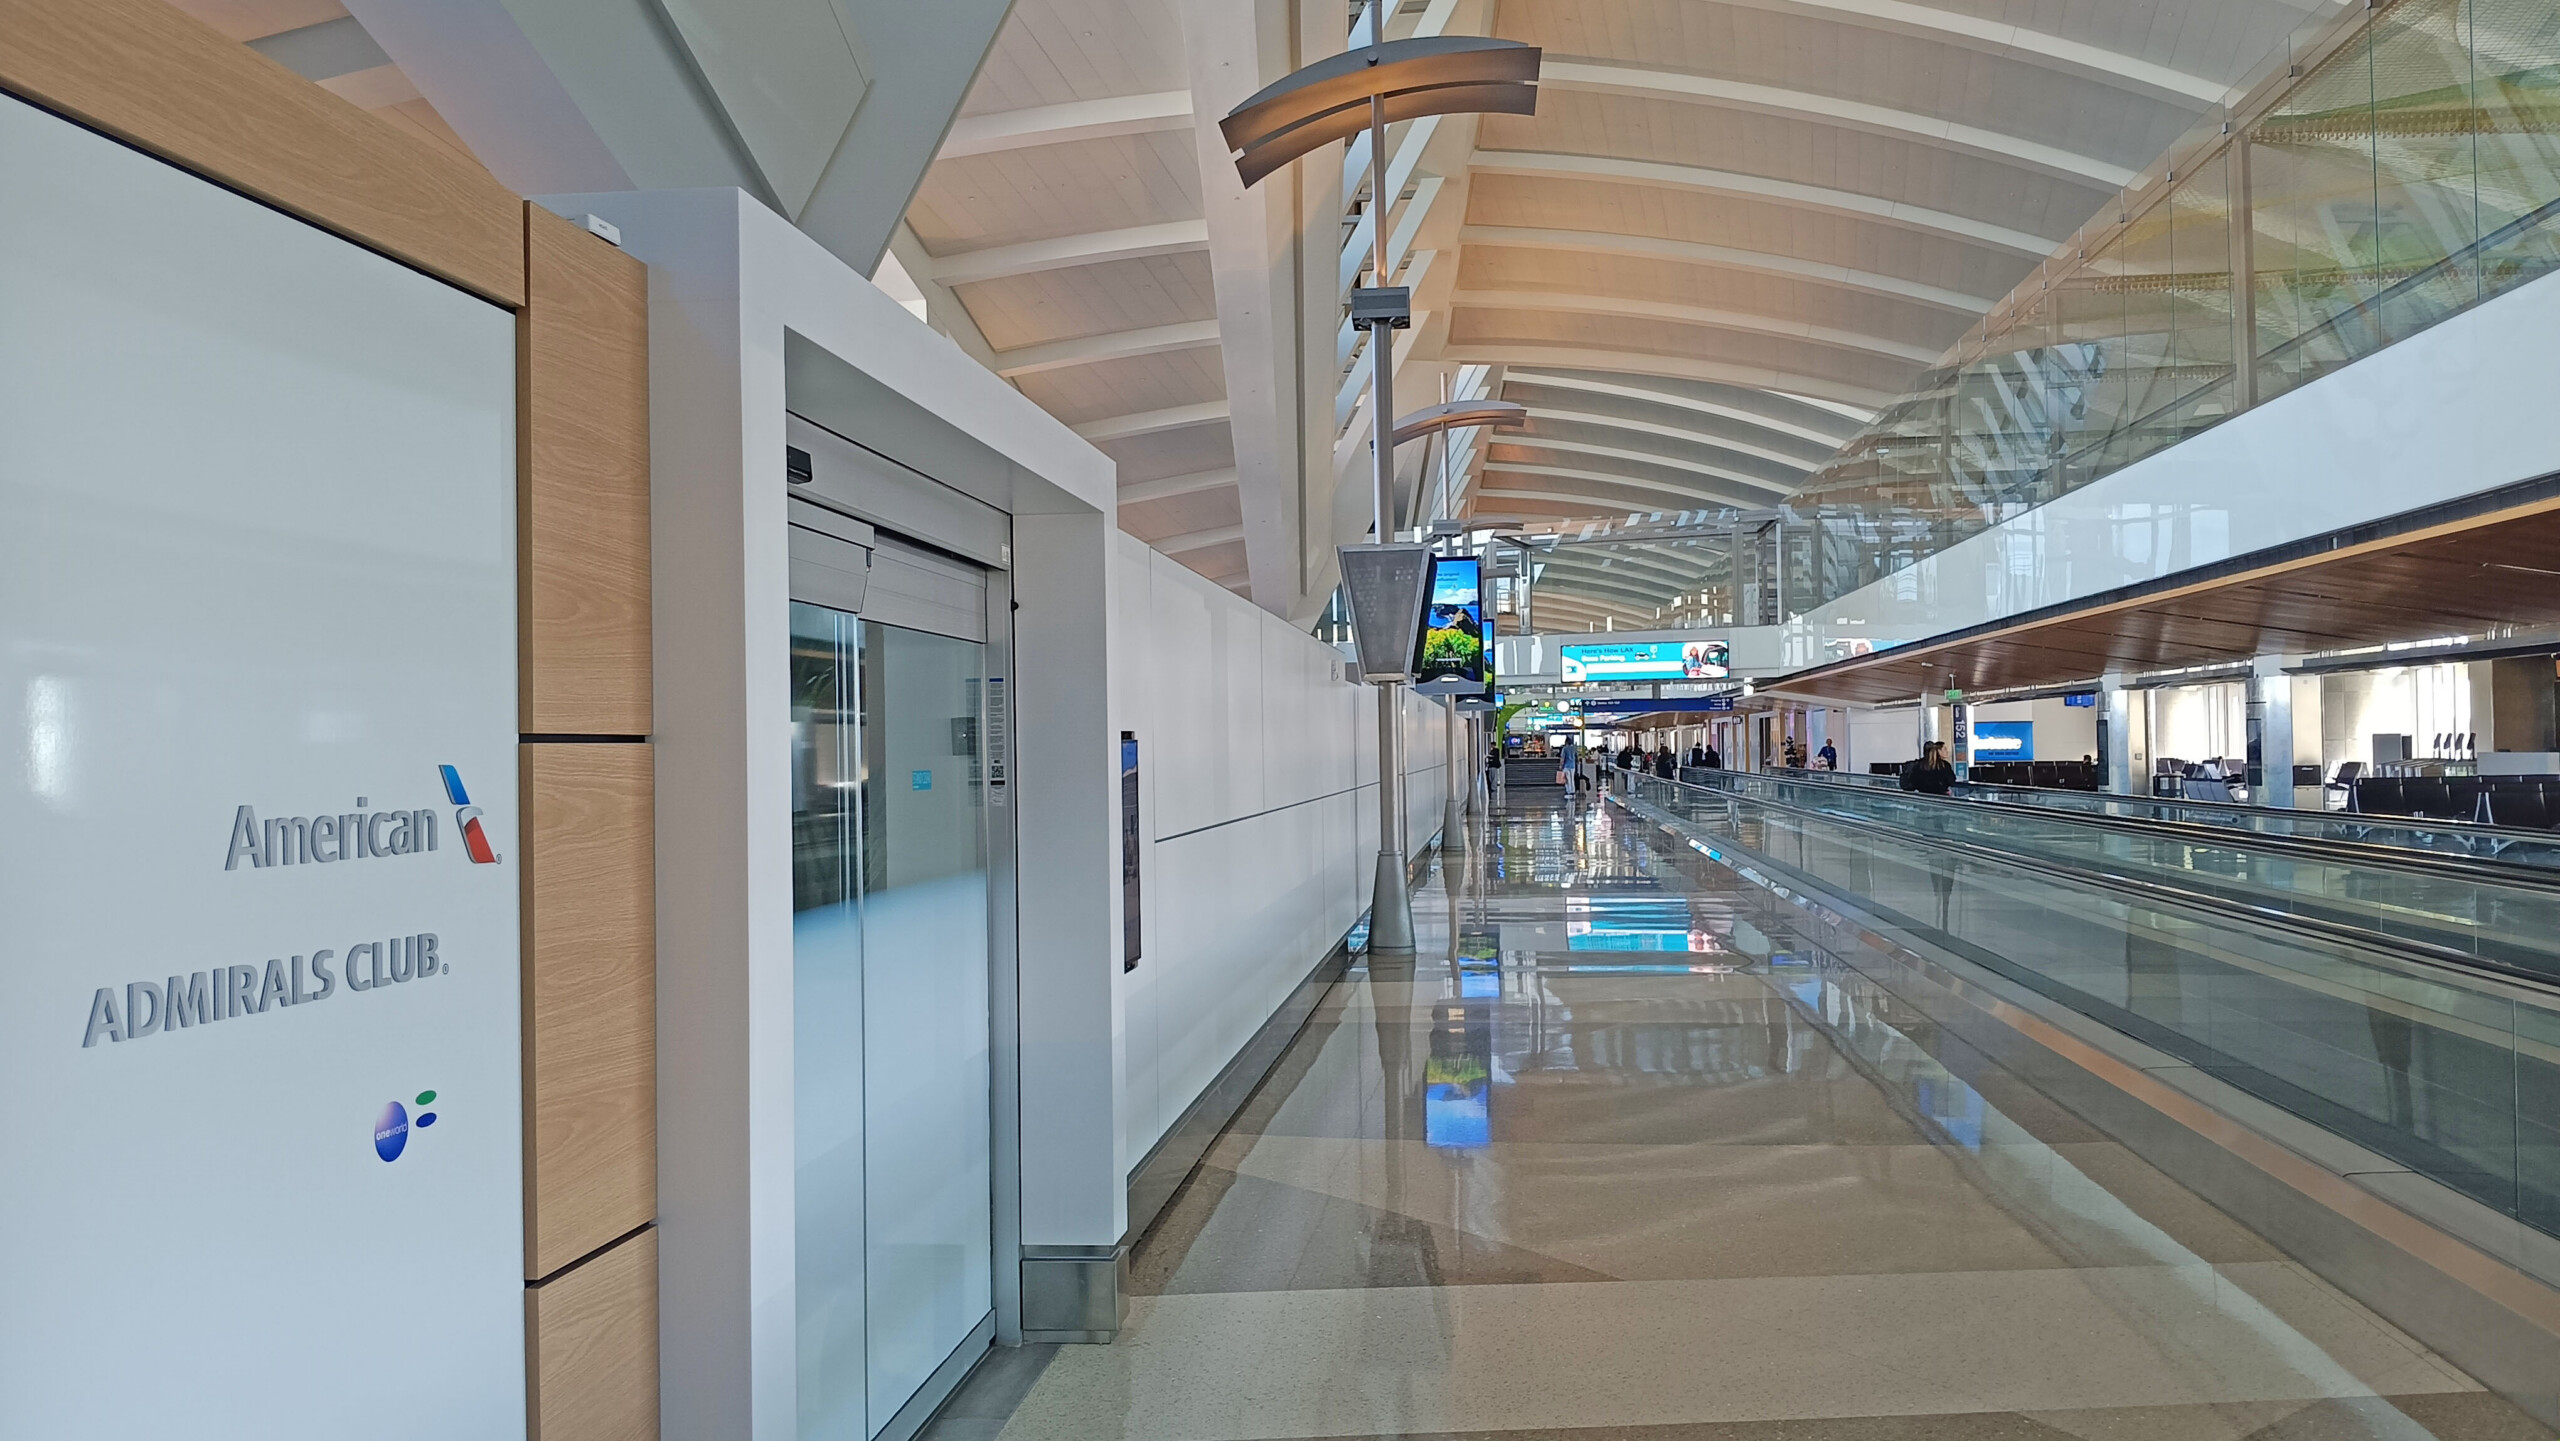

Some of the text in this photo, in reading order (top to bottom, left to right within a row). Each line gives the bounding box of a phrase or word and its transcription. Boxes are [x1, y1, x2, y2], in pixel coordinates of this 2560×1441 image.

[1955, 719, 1966, 739] 152
[225, 797, 438, 871] American
[82, 949, 336, 1048] ADMIRALS
[376, 1122, 407, 1141] oneworld
